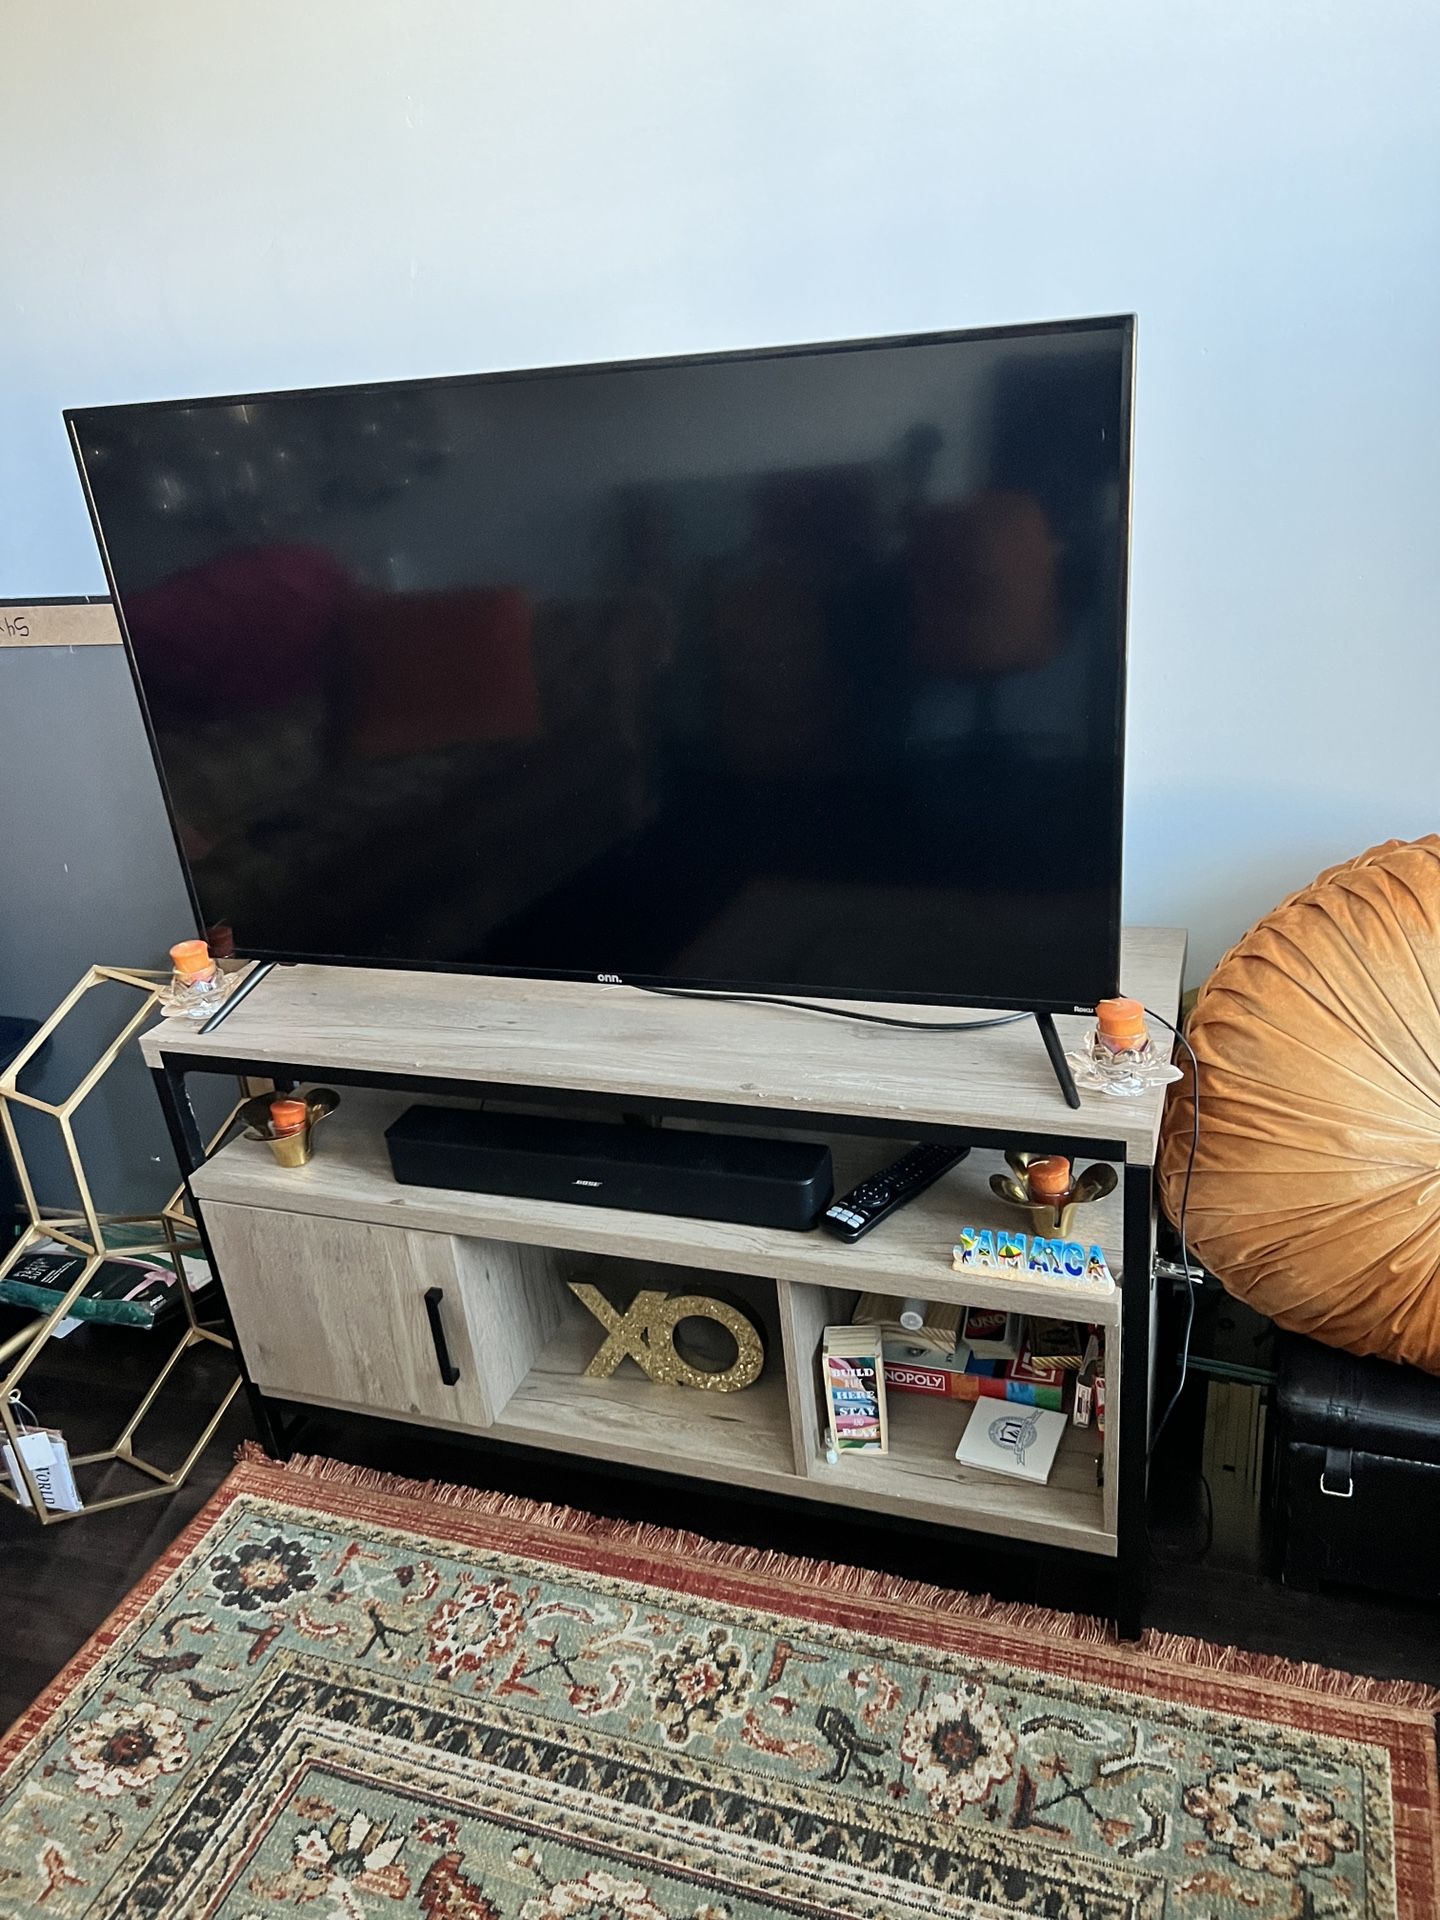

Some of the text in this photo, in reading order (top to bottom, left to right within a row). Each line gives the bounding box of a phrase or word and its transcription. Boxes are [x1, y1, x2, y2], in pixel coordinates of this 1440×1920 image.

[952, 1225, 1114, 1286] JAMAICA
[967, 1312, 1006, 1329] UNO
[567, 1281, 764, 1393] XO
[831, 1367, 875, 1378] BUILD
[884, 1370, 942, 1387] NOPOLY
[836, 1390, 875, 1400] HERE
[839, 1406, 876, 1416] STAY
